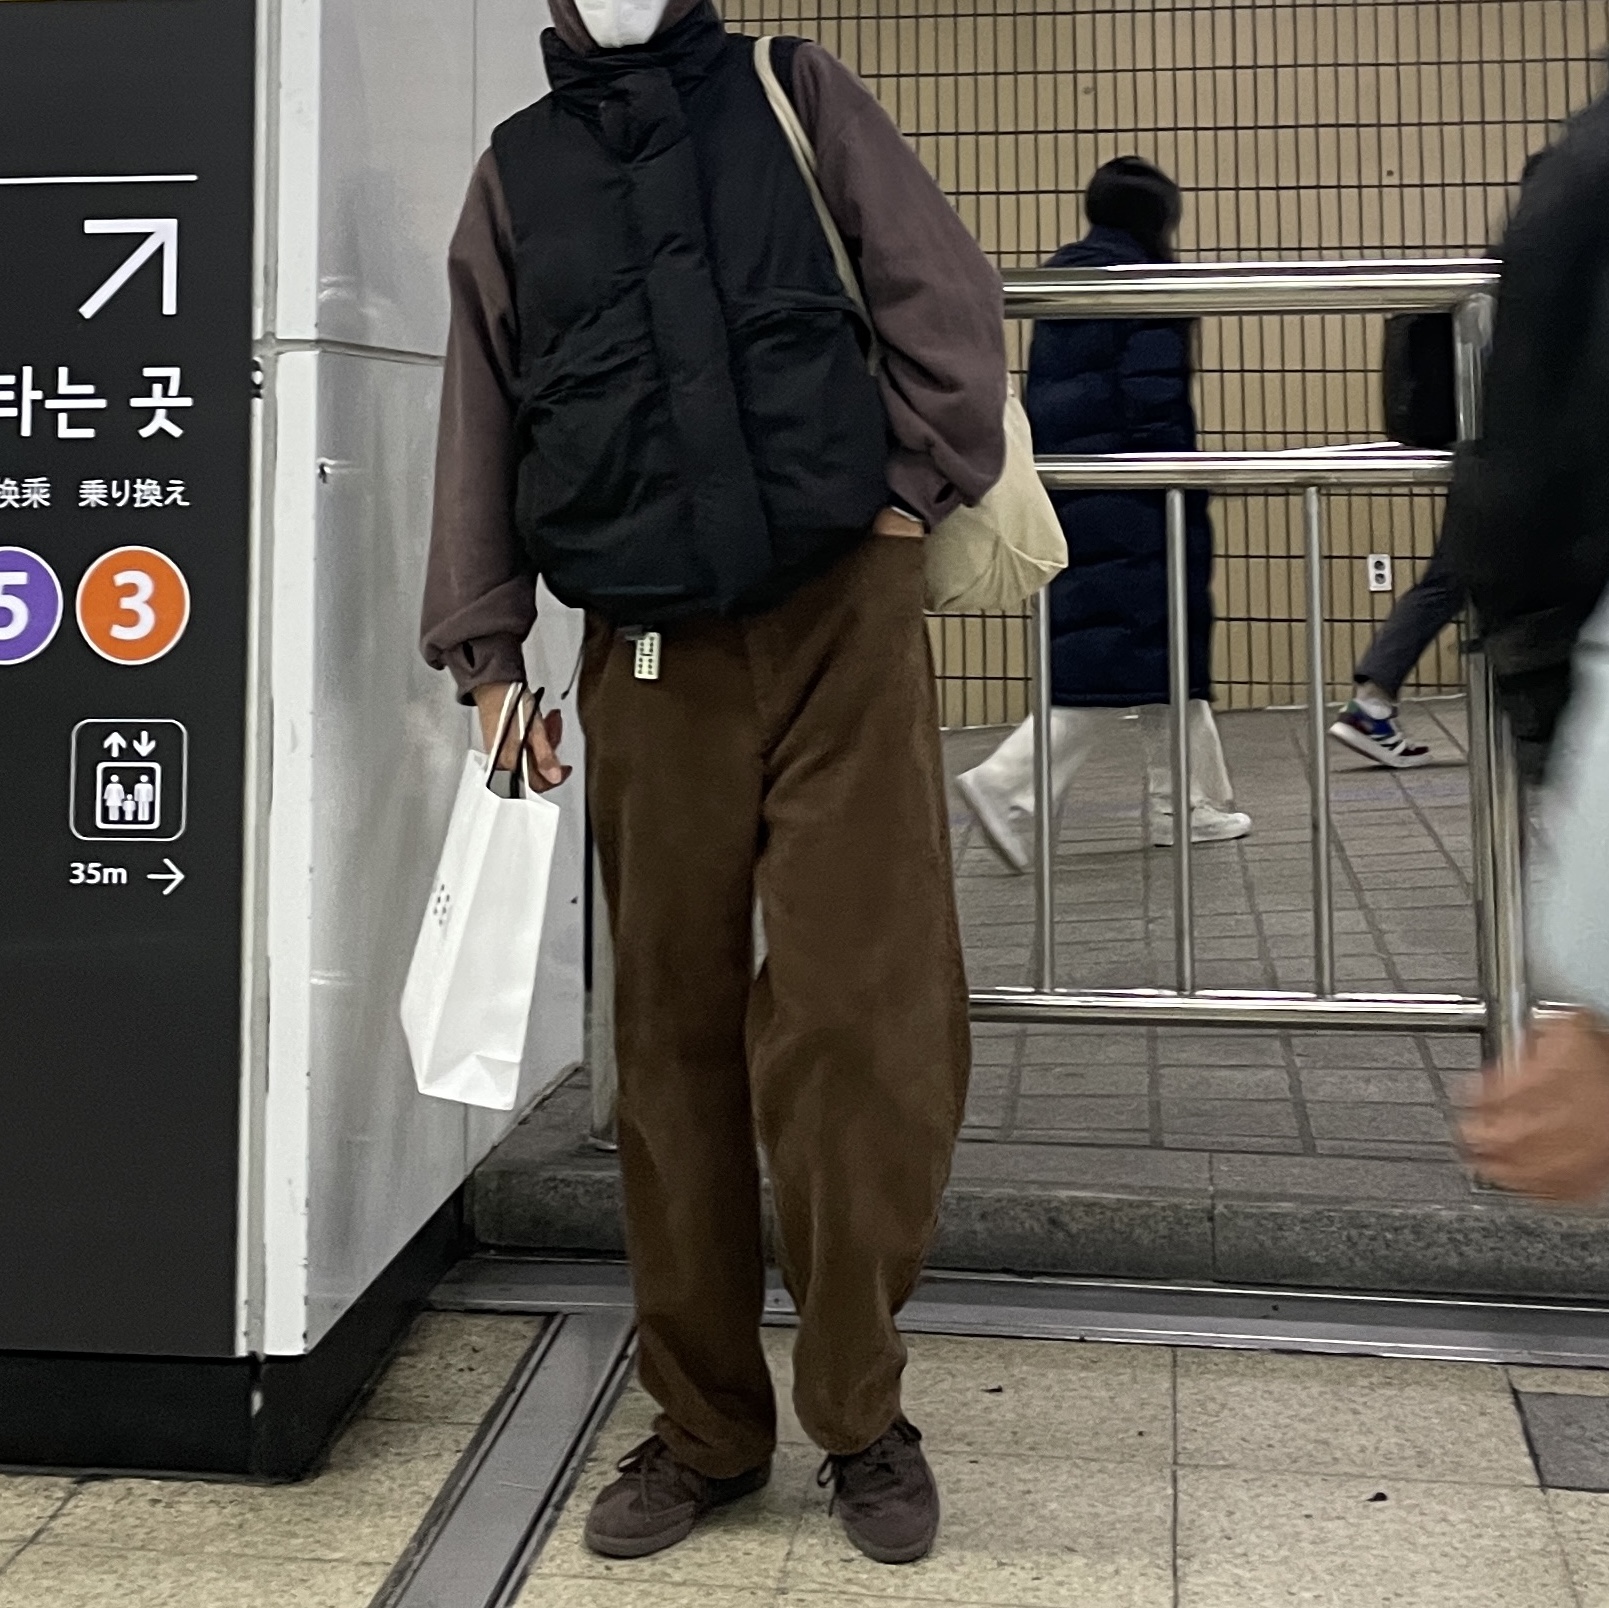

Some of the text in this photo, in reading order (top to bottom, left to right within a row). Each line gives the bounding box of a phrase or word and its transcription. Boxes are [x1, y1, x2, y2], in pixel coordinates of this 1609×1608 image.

[0, 366, 193, 438] 타는 곳
[78, 479, 190, 507] 乗り換え
[0, 570, 156, 640] 5 3
[69, 862, 127, 884] 35m
